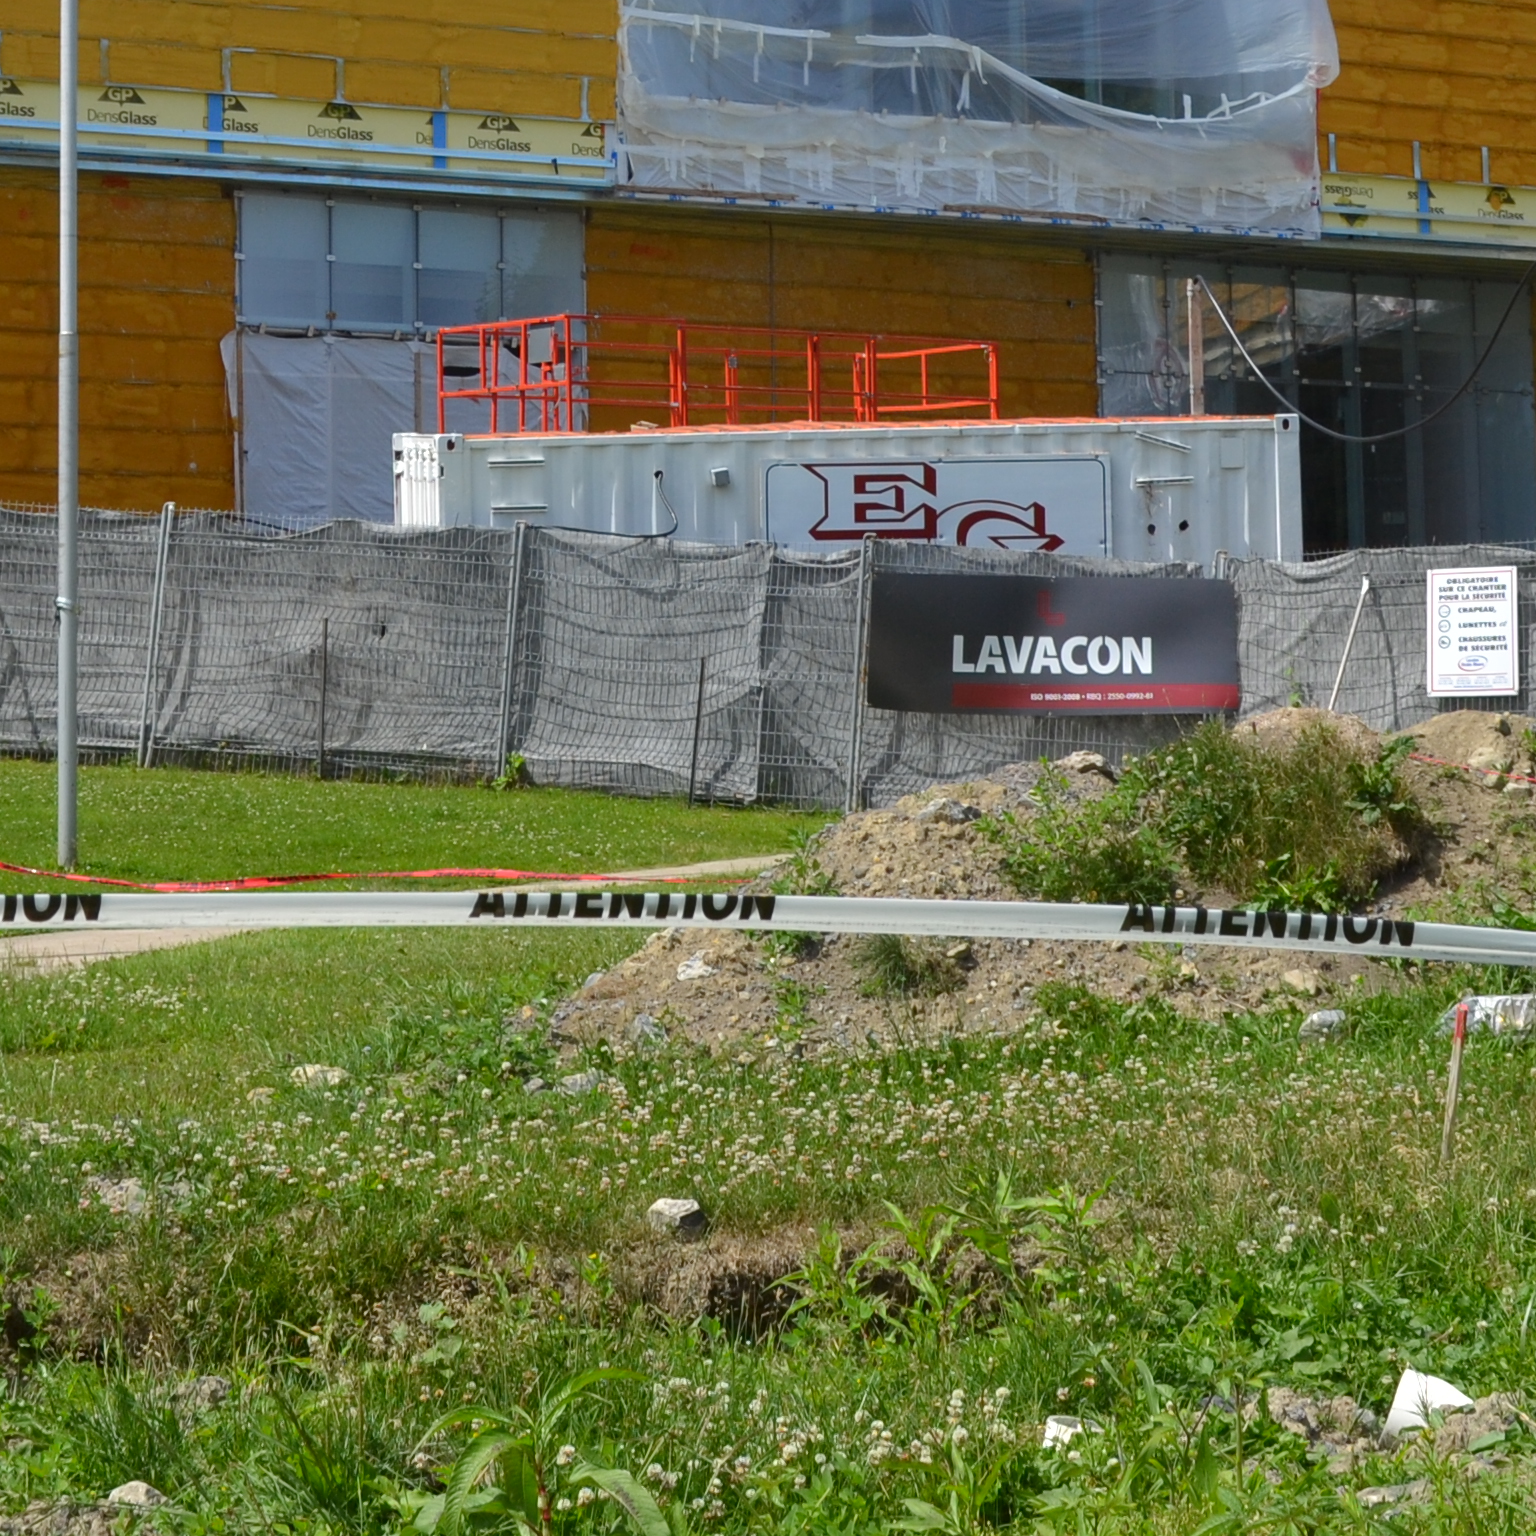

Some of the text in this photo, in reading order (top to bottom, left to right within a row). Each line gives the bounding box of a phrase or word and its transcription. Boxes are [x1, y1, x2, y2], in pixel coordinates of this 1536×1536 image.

[107, 87, 133, 101] GP
[88, 108, 157, 126] DensGlass
[486, 117, 510, 130] GP
[308, 124, 373, 141] DensGlass
[468, 135, 532, 152] DensGlass
[1446, 576, 1498, 584] OBLIGATOIRE
[952, 635, 1152, 676] LAVACON
